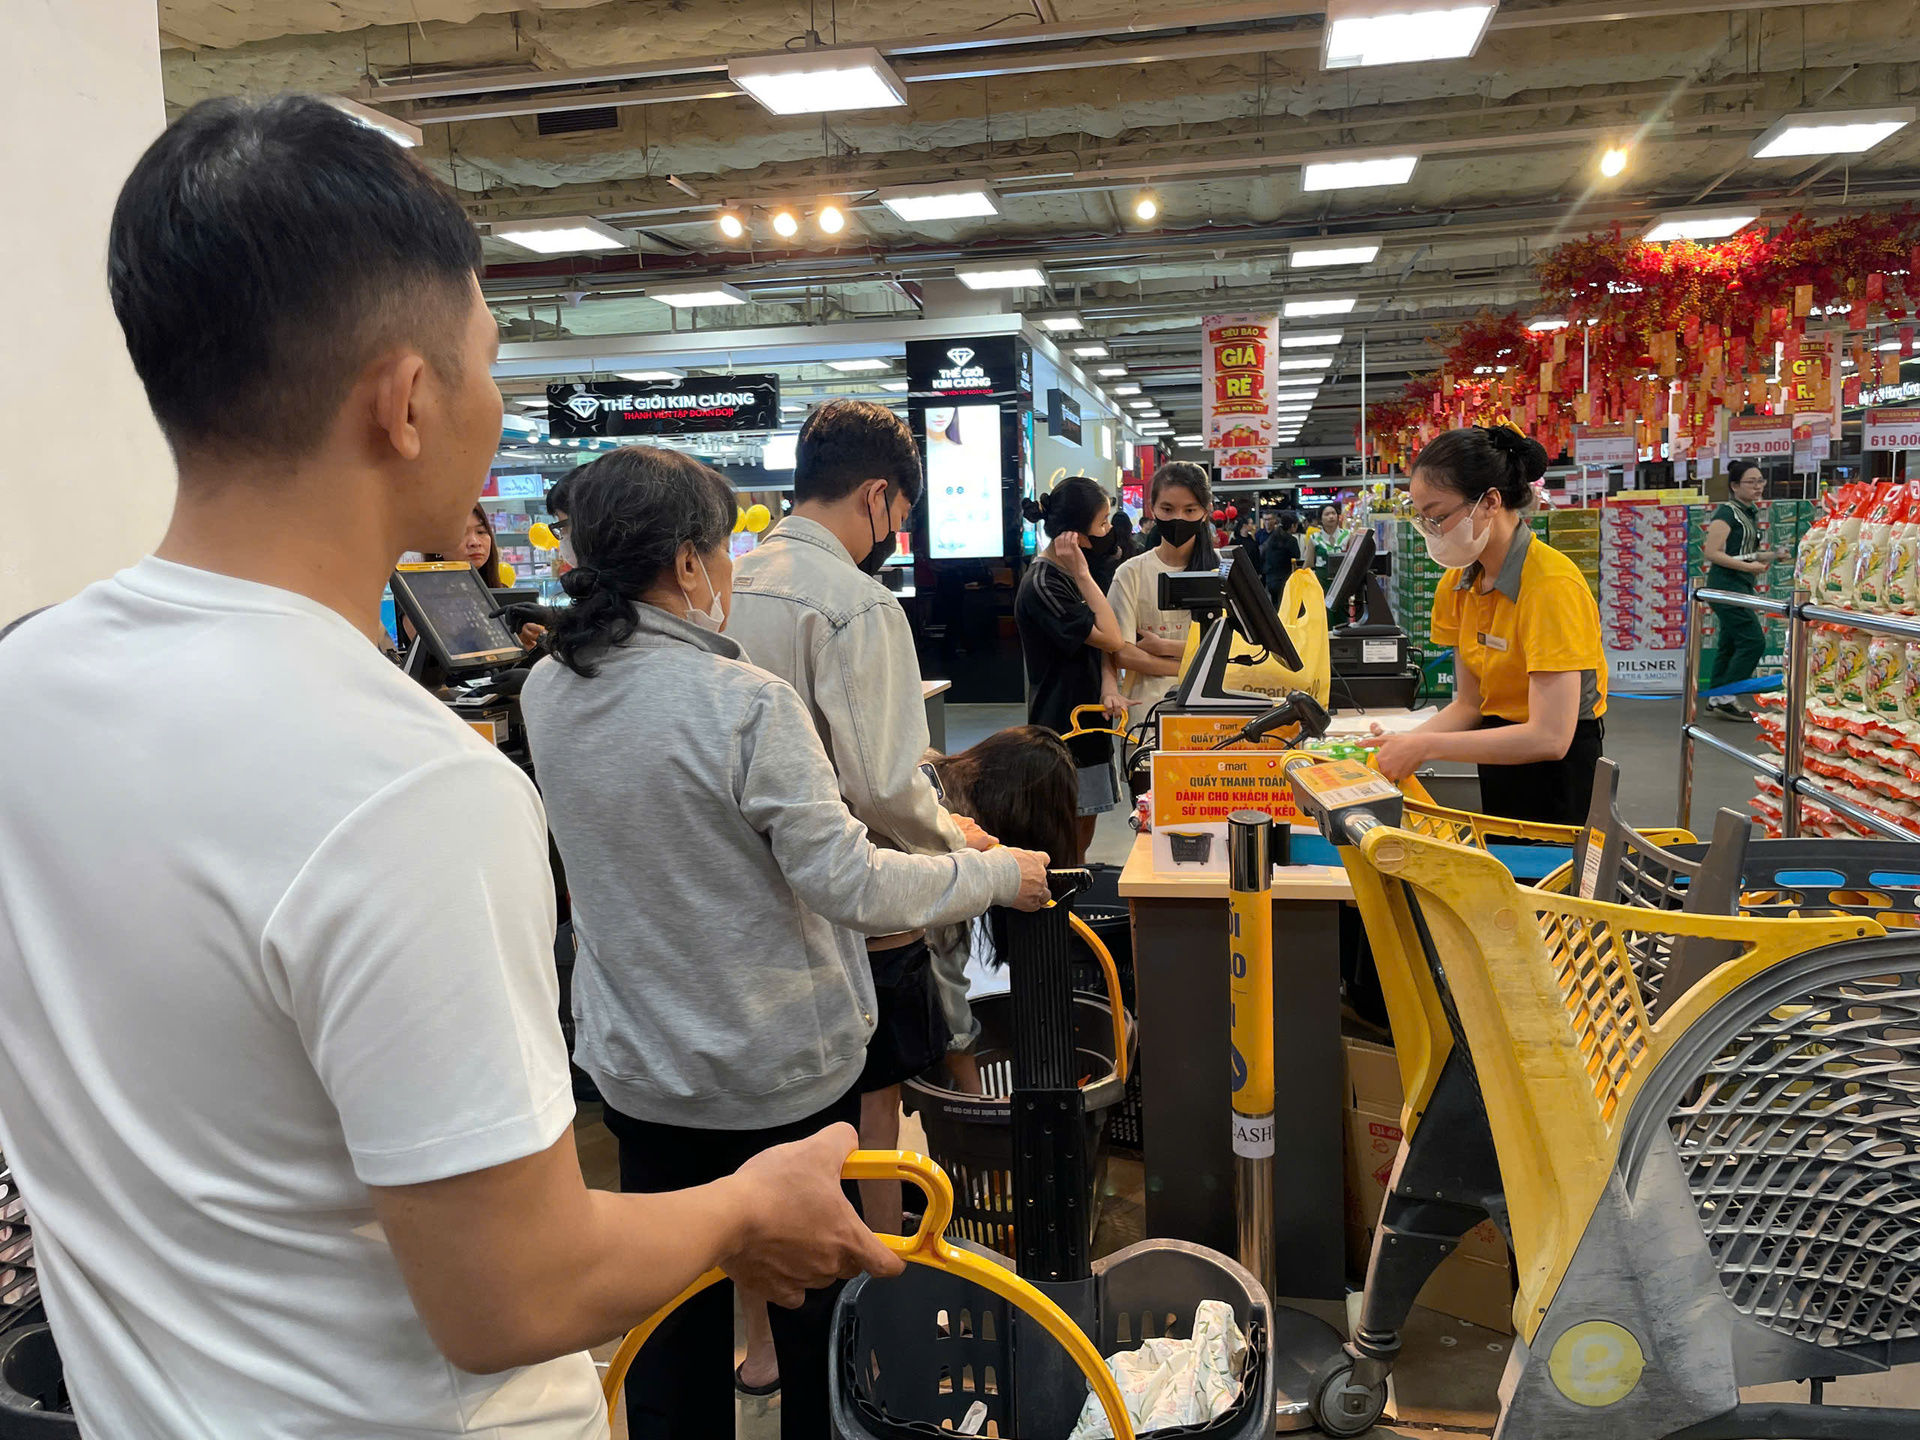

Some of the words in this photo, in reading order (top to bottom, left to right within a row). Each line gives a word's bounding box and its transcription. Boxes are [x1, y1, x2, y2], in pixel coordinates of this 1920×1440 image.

[1221, 345, 1257, 367] GIÁ
[939, 366, 962, 379] THẾ
[932, 379, 953, 388] KIM
[1226, 374, 1252, 397] RẺ
[602, 394, 633, 411] THẾ
[635, 393, 666, 410] GIỚI
[667, 394, 697, 409] KIM
[698, 392, 755, 408] CƯƠNG
[624, 411, 652, 420] THÀNH
[653, 410, 672, 420] VIÊN
[673, 410, 689, 419] TẬP
[1871, 434, 1920, 447] 619.00
[1735, 441, 1790, 454] 329.000
[1617, 660, 1677, 671] PILSNER
[1214, 723, 1238, 731] emart
[1191, 734, 1216, 744] QUẤY
[1217, 762, 1248, 771] emart
[1190, 774, 1218, 787] QUẤY
[1219, 777, 1255, 787] THANH
[1258, 774, 1287, 787] TOÁN
[1176, 789, 1204, 801] DÀNH
[1207, 791, 1229, 802] CHO
[1232, 789, 1269, 802] KHÁCH
[1271, 789, 1294, 801] HÀN
[1182, 803, 1197, 816] SỬ
[1200, 806, 1229, 818] DỤNG
[1274, 804, 1296, 816] KÉO
[1234, 1123, 1274, 1143] ASH
[1571, 1333, 1624, 1394] e
